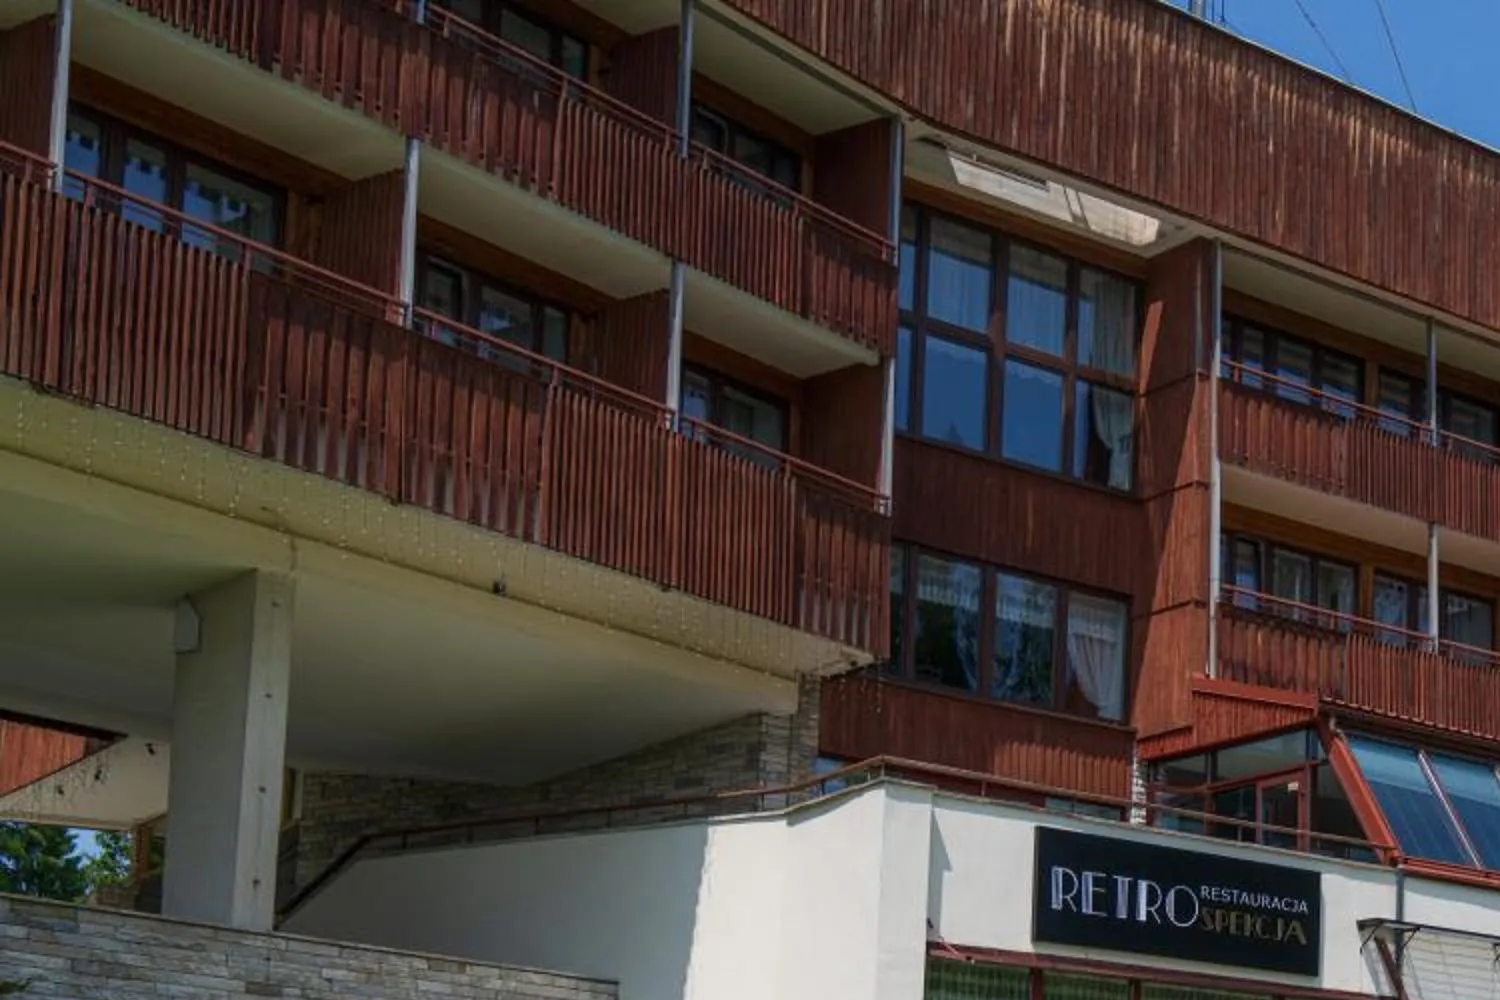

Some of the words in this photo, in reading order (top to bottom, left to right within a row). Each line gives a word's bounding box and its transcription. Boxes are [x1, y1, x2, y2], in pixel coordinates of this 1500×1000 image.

[1051, 866, 1199, 927] RETRO
[1200, 885, 1309, 915] RESTAURACJA
[1201, 907, 1307, 944] SPEKCJA
